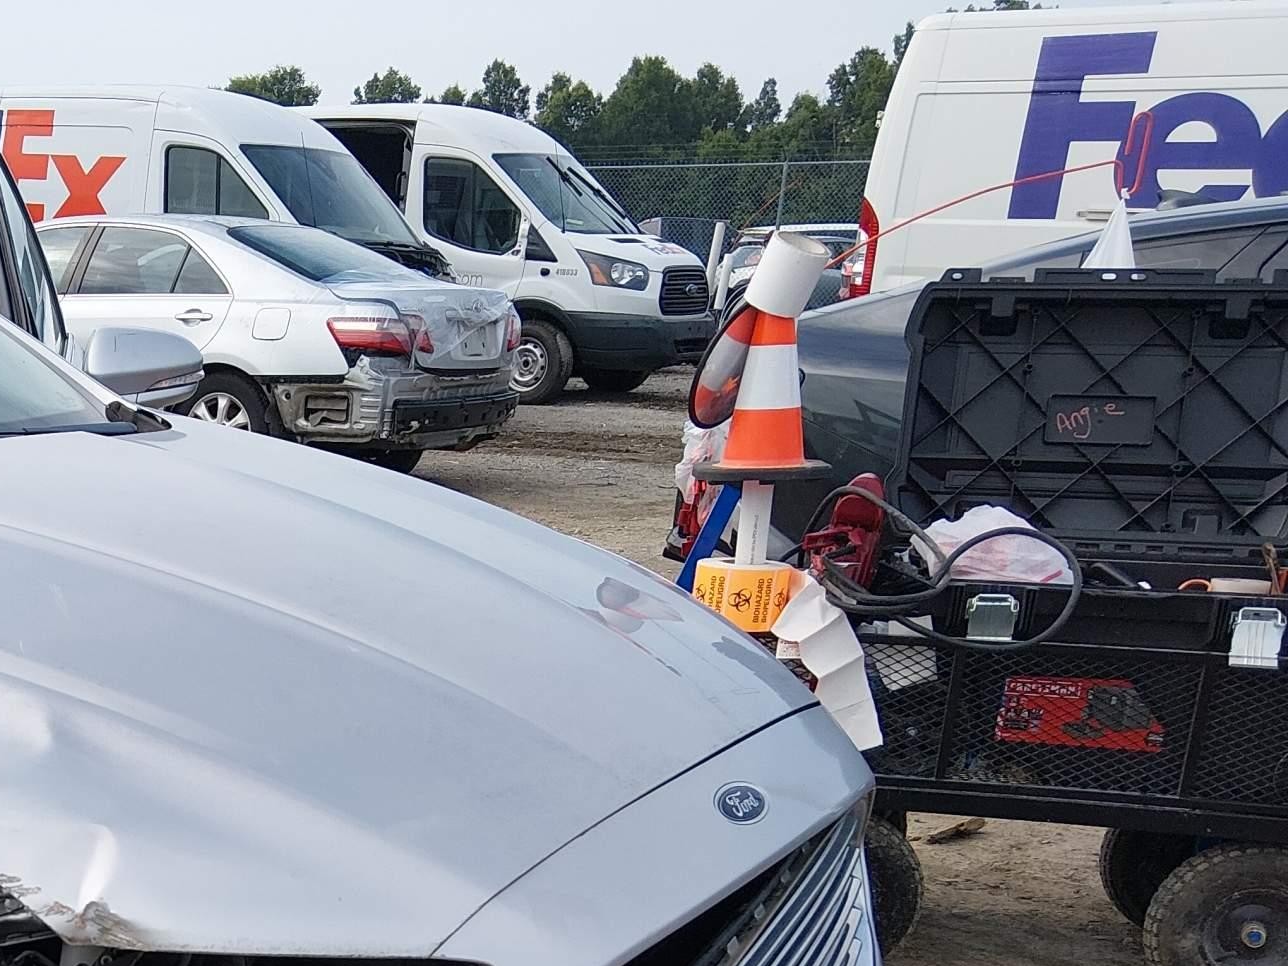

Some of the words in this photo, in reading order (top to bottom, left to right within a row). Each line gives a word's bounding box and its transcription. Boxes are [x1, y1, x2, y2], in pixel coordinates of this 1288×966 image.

[752, 578, 765, 623] BIOHAZARD
[761, 577, 773, 623] BIOPELIGRO
[725, 791, 760, 817] Ford
